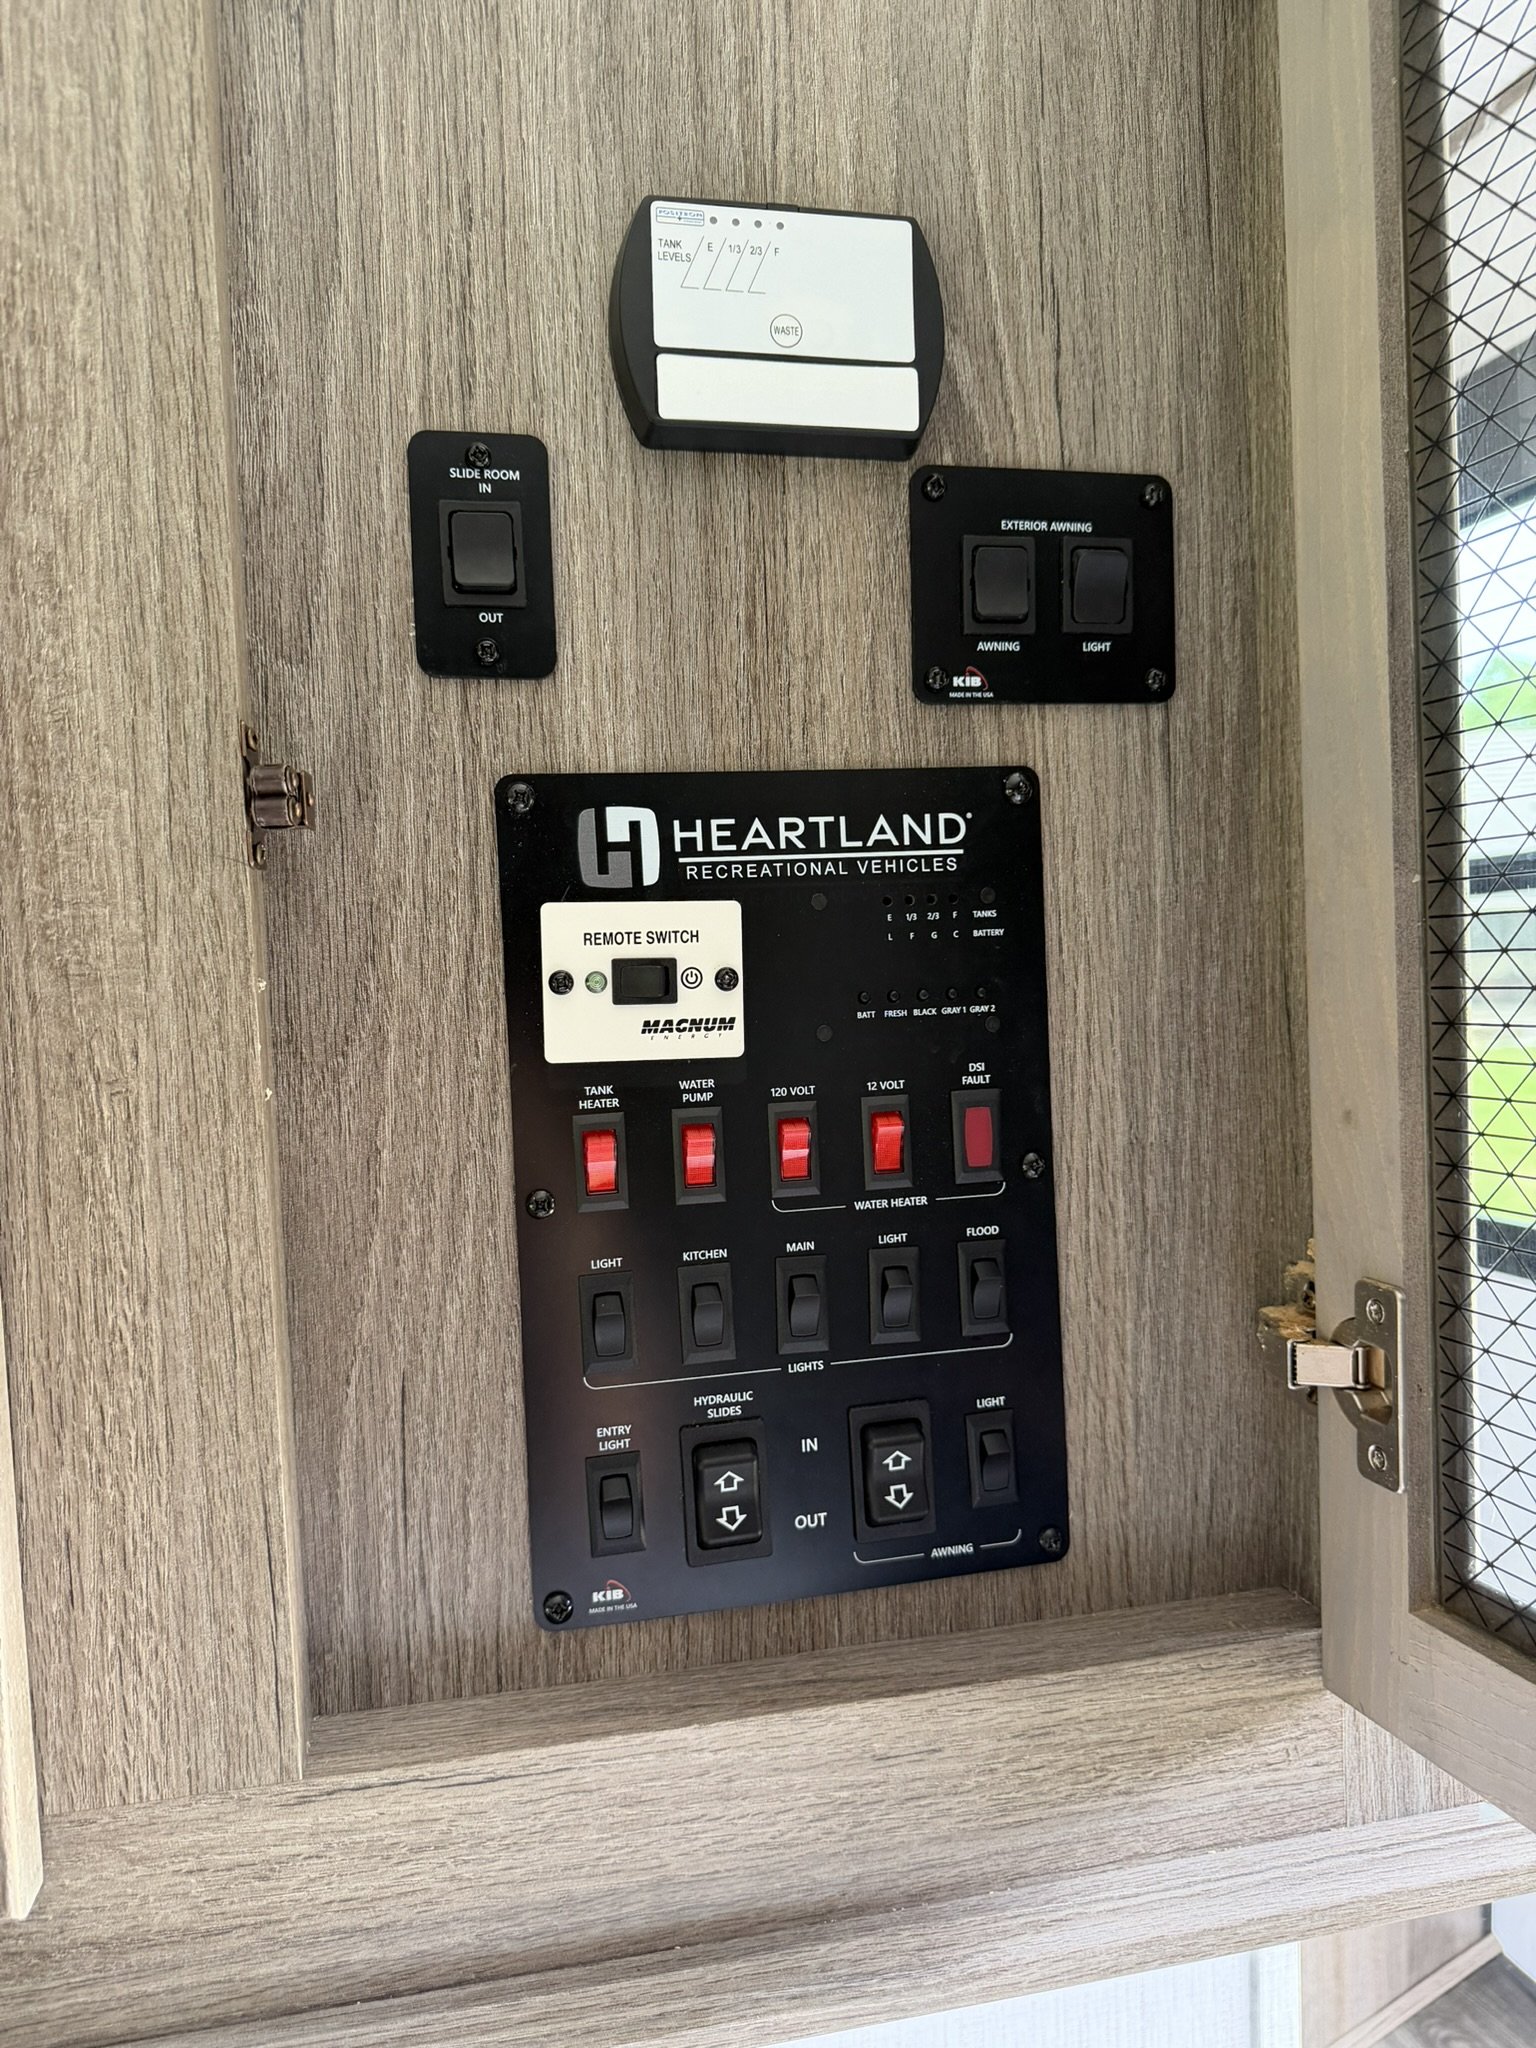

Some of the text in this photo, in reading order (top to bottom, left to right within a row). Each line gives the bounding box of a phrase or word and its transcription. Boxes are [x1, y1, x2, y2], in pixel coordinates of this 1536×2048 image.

[658, 239, 682, 249] TANK
[707, 242, 714, 252] E
[729, 244, 741, 254] 1/3
[658, 251, 691, 262] LEVELS
[750, 246, 762, 256] 2/3
[774, 247, 780, 257] F
[774, 326, 799, 336] WASTE
[449, 468, 519, 480] SLIDE ROOM
[479, 483, 491, 493] IN
[1001, 520, 1092, 532] EXTERIOR AWNING
[479, 613, 503, 623] OUT
[977, 642, 1020, 651] AWNING
[1083, 642, 1111, 652] LIGHT
[952, 674, 981, 687] KIB
[686, 857, 957, 879] RECREATIONAL VEHICLES
[887, 913, 893, 922] E
[906, 913, 917, 921] 1/3
[928, 912, 939, 920] 2/3
[952, 910, 958, 919] F
[584, 930, 699, 945] REMOTE SWITCH
[887, 929, 1004, 941] L F G C BATTERY
[913, 1008, 937, 1016] BLACK
[969, 1004, 996, 1014] GRAY 2
[857, 1011, 875, 1019] BATT
[641, 1017, 736, 1034] MAGNUM
[969, 1063, 984, 1072] DSI
[679, 1079, 714, 1090] WATER
[867, 1080, 904, 1090] 12 VOLT
[962, 1075, 991, 1084] FAULT
[584, 1085, 613, 1095] TANK
[771, 1086, 815, 1096] 120 VOLT
[683, 1092, 713, 1102] PUMP
[579, 1098, 619, 1109] HEATER
[855, 1196, 927, 1210] WATER HEATER
[967, 1226, 999, 1236] FLOOD
[879, 1233, 907, 1244] LIGHT
[787, 1241, 814, 1252] MAIN
[683, 1249, 727, 1261] KITCHEN
[591, 1258, 622, 1269] LIGHT
[788, 1360, 824, 1373] LIGHTS
[694, 1391, 753, 1406] HYDRAULIC
[977, 1396, 1005, 1408] LIGHT
[707, 1405, 742, 1418] SLIDES
[596, 1425, 631, 1437] ENTRY
[599, 1439, 630, 1450] LIGHT
[802, 1438, 817, 1452] IN
[795, 1512, 827, 1528] OUT
[931, 1543, 973, 1557] AWNING
[592, 1590, 624, 1602] KIB
